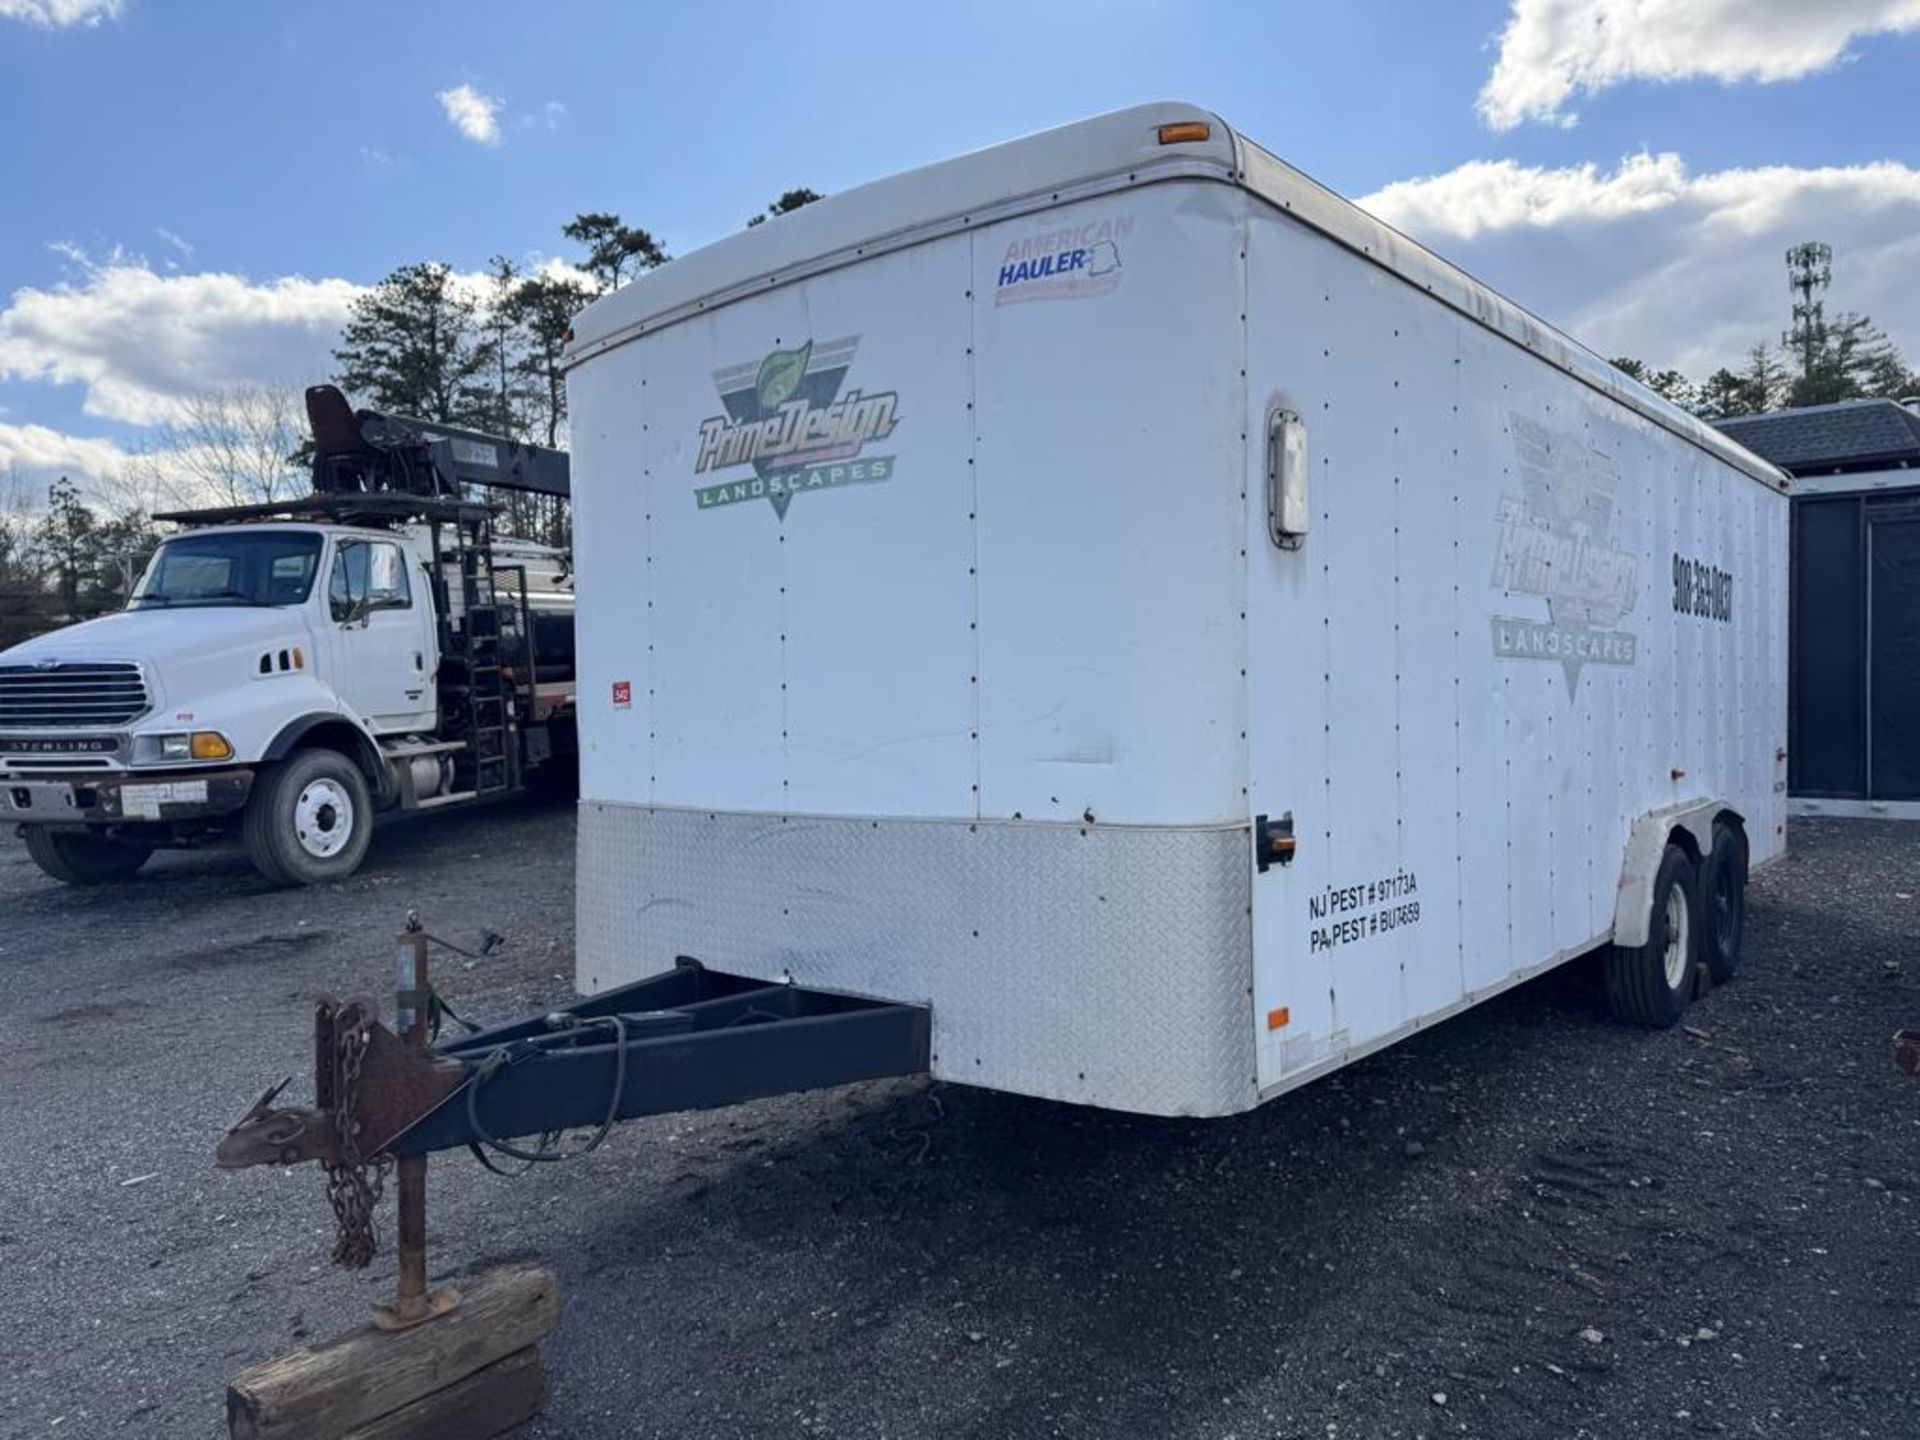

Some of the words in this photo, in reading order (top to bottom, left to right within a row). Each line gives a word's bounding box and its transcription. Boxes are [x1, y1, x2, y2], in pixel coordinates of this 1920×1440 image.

[1003, 215, 1135, 263] AMERICAN
[998, 247, 1086, 286] HAULER
[702, 461, 888, 505] LANDSCAPES
[1500, 627, 1634, 661] LANDSCAPES
[10, 741, 103, 751] STERLING
[1309, 893, 1327, 920] NJ
[1330, 884, 1366, 914] PEST
[1368, 882, 1376, 905] #
[1378, 873, 1418, 901] 97173A
[1332, 916, 1368, 946] PEST
[1370, 913, 1378, 937] #
